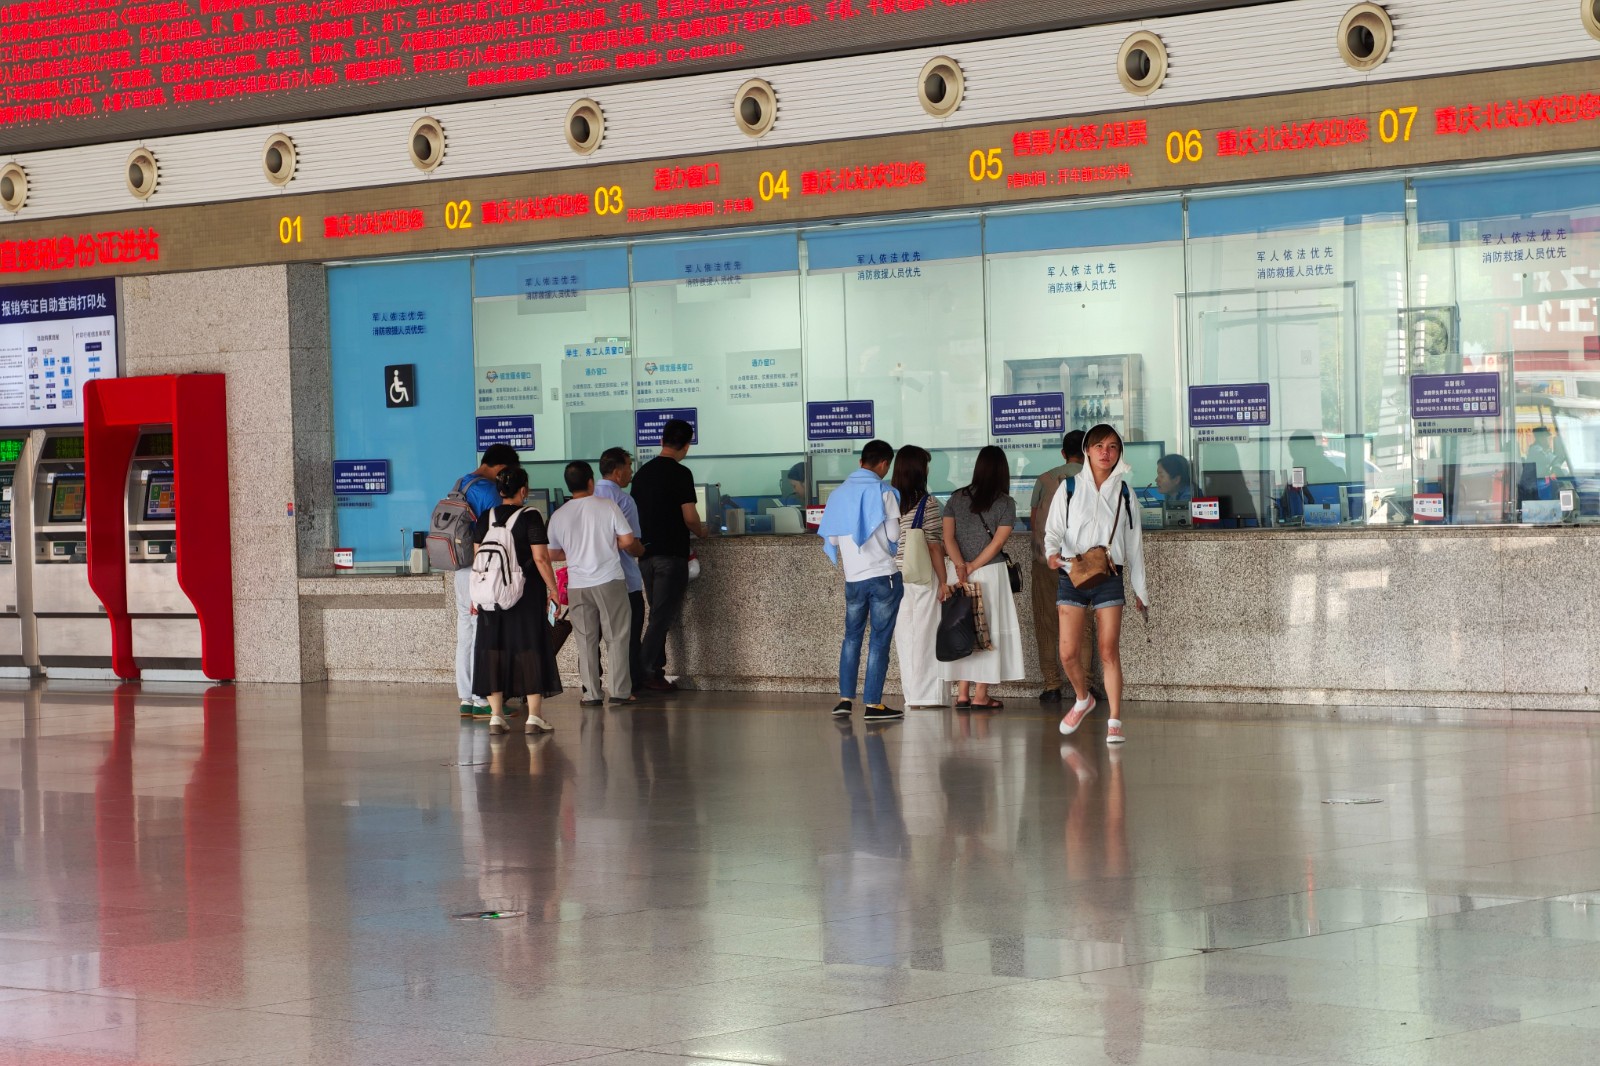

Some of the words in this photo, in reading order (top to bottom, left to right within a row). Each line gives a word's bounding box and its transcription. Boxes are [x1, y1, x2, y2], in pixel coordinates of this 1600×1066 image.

[1378, 106, 1418, 144] 07
[1434, 92, 1600, 135] 重庆北站欢迎您
[1011, 120, 1148, 157] 售票/改签/退票
[1165, 129, 1203, 164] 06
[1216, 117, 1369, 156] 重庆北站欢迎您
[653, 163, 720, 191] 通办窗口
[800, 161, 926, 195] 重庆北站欢迎您
[968, 147, 1003, 182] 05
[758, 169, 790, 201] 04
[444, 199, 473, 230] 02
[481, 193, 590, 224] 重庆北站欢迎您
[594, 185, 624, 216] 03
[279, 215, 302, 244] 01
[324, 209, 425, 238] 重庆北站欢迎您
[1482, 227, 1567, 244] 军人依法优先
[0, 228, 159, 273] 直接刷身份证进站
[857, 252, 921, 265] 军人依法优先
[1256, 247, 1334, 264] 军人依法优先
[1482, 246, 1567, 264] 消防救援人员优先
[857, 267, 921, 281] 消防救援人员优先
[1048, 262, 1116, 277] 军人依法优先
[1257, 264, 1334, 280] 消防救援人员优先
[1048, 279, 1116, 294] 消防救援人员优先
[2, 293, 107, 317] 报销凭证自助查询打印处
